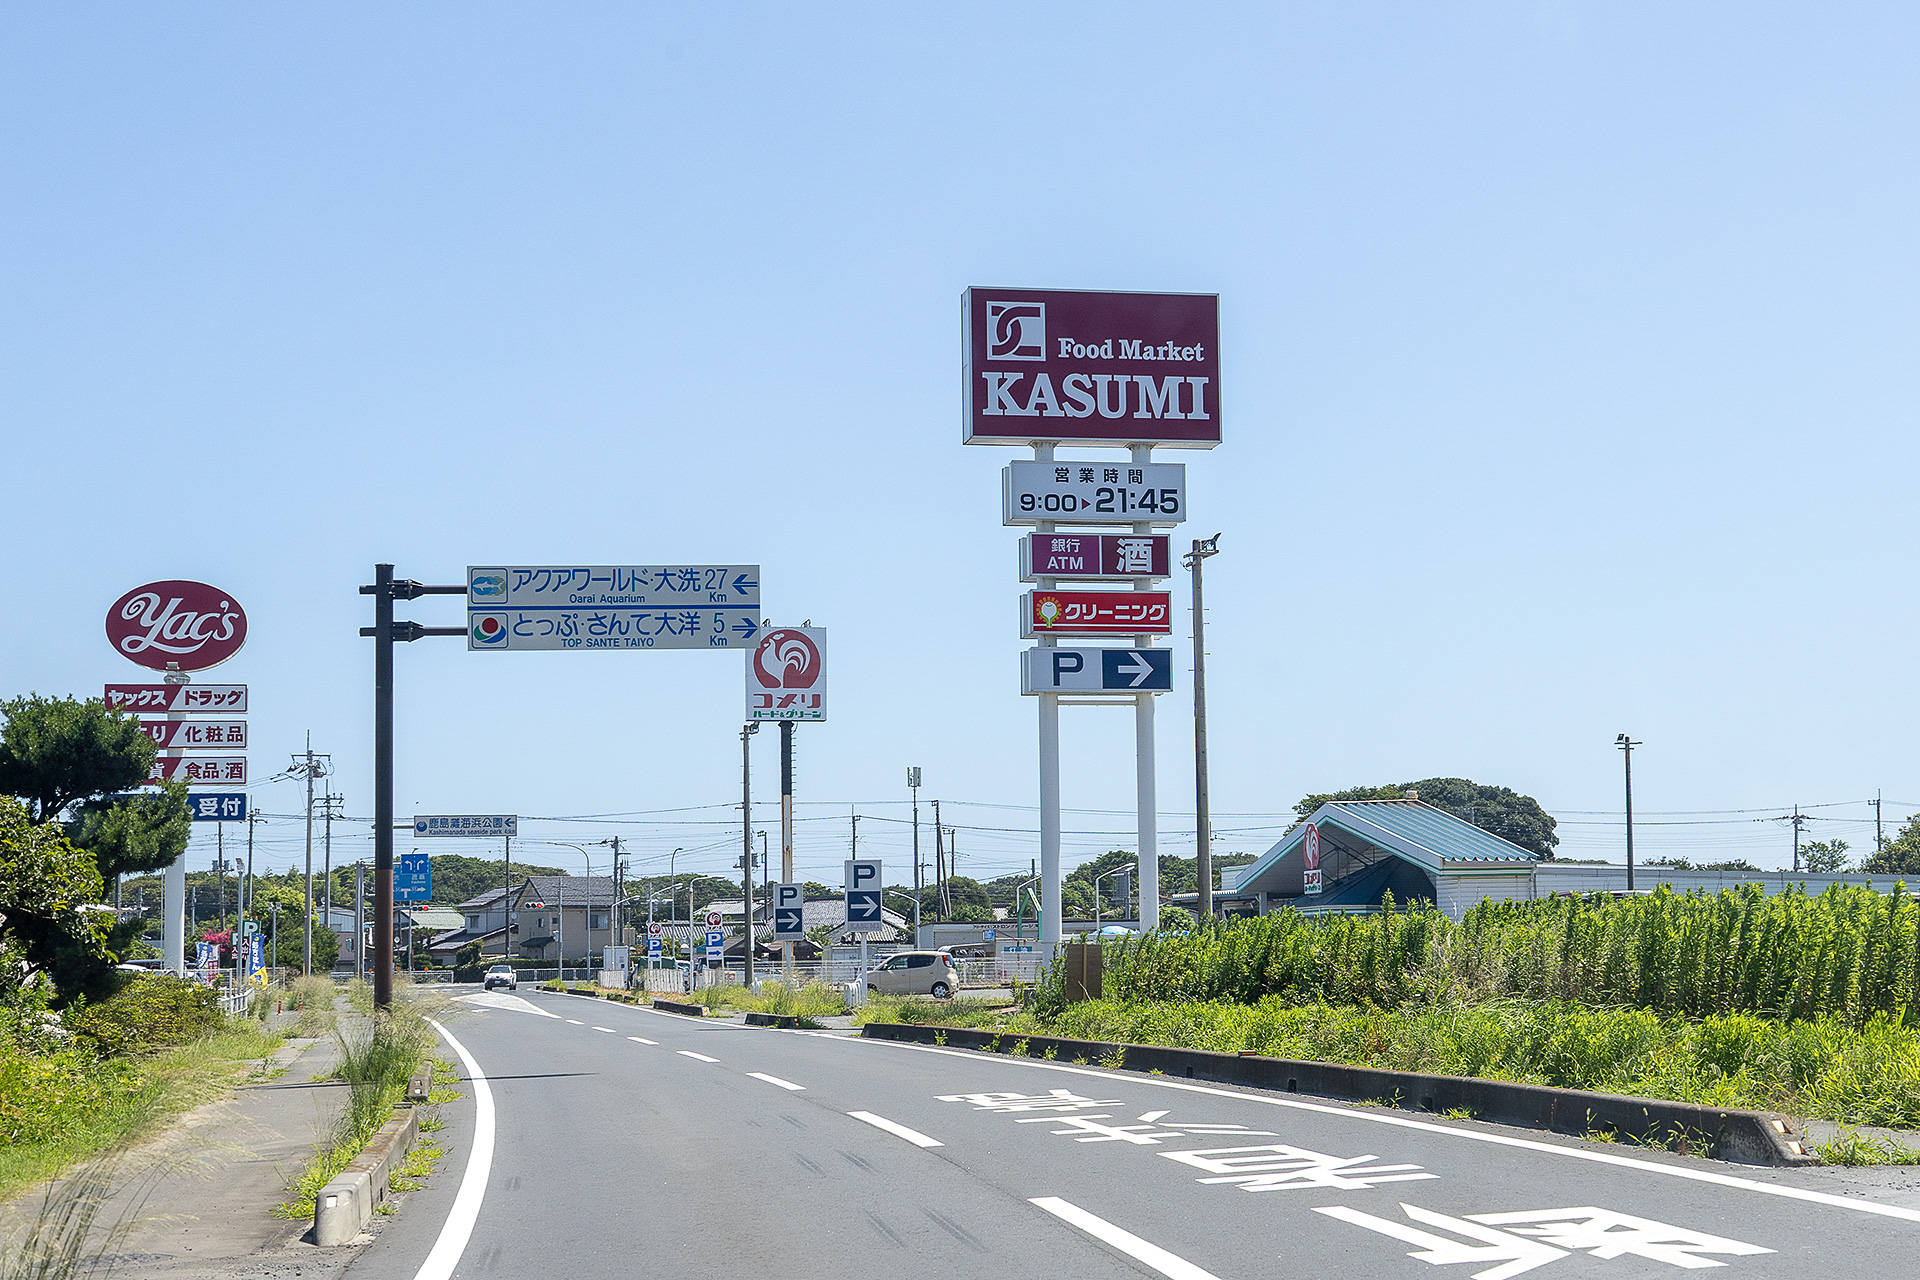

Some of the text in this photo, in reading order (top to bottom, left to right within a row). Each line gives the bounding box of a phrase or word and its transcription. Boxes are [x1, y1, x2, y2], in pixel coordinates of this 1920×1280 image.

[1057, 337, 1206, 362] Food Market
[981, 371, 1210, 420] KASUMI
[1054, 467, 1143, 485] 営業時間
[1020, 487, 1179, 514] 9:00 21:45
[1050, 538, 1081, 553] 銀行
[1046, 556, 1084, 570] ATM
[1116, 538, 1154, 573] 酒
[512, 568, 729, 593] アクアワールド・大洗 27
[569, 591, 728, 605] Oarai Aquarium Km
[1064, 603, 1167, 621] クリーニング
[119, 592, 240, 654] Yac's
[512, 612, 726, 638] とっぷ・さんて大洋 5
[561, 635, 728, 648] TOP SANTE TAIYO Km
[1052, 651, 1084, 687] P
[108, 690, 244, 706] ヤックス ドラッグ
[753, 693, 821, 709] コメリ
[184, 725, 244, 743] 化粧品
[186, 797, 242, 817] 受付
[428, 828, 466, 836] Kashimanada
[489, 828, 503, 836] park
[853, 864, 876, 889] P
[779, 886, 798, 907] P
[243, 921, 259, 937] P
[649, 940, 661, 951] P
[707, 933, 722, 946] P
